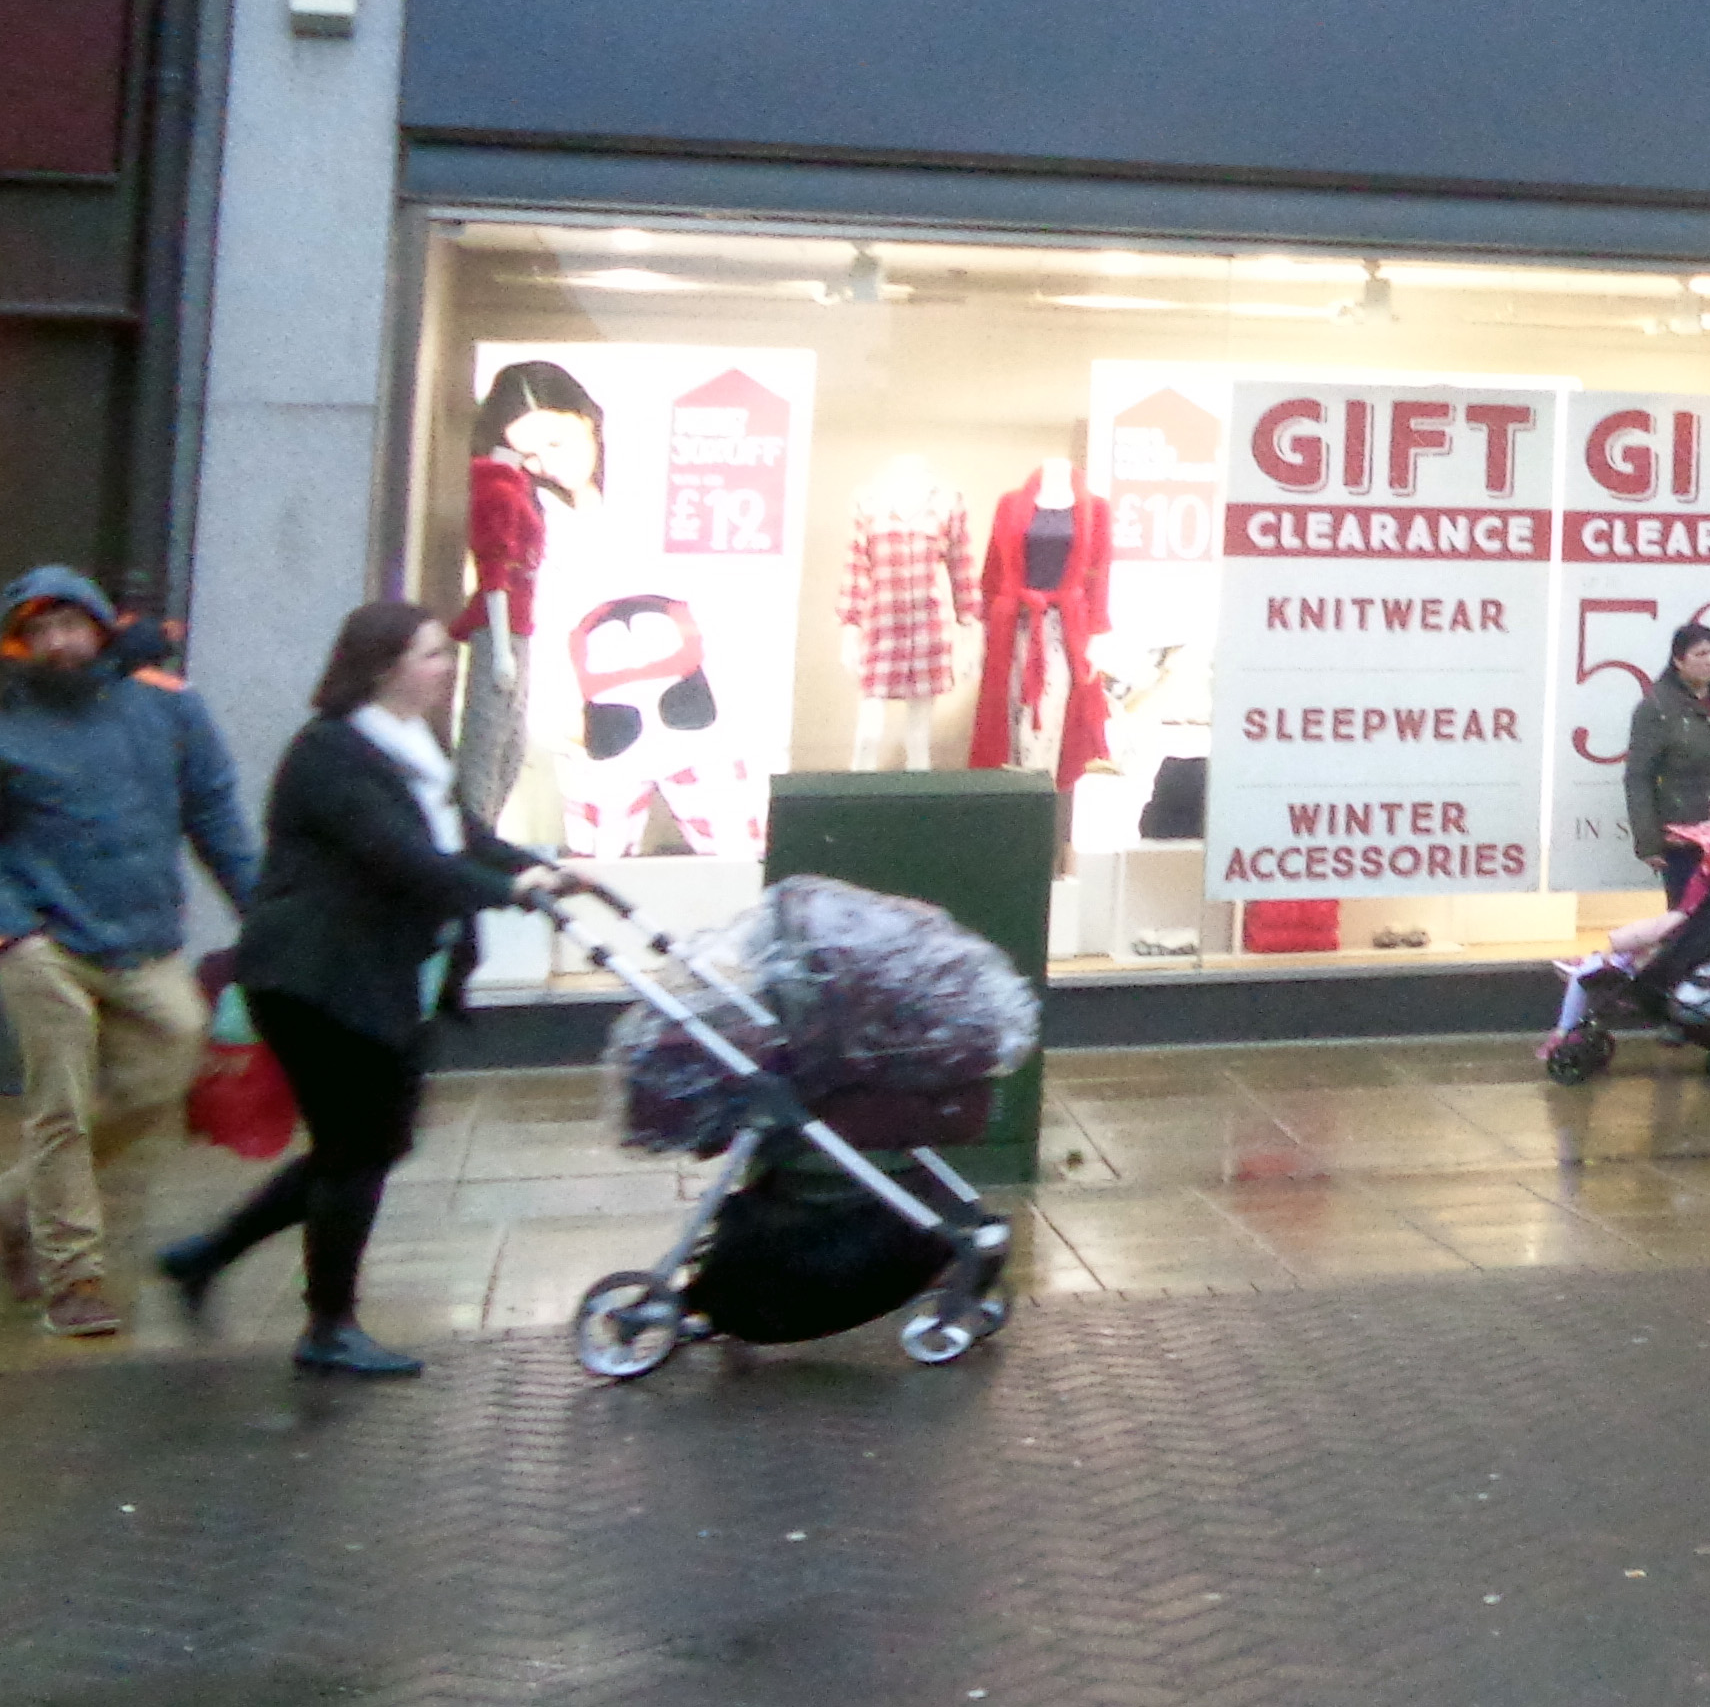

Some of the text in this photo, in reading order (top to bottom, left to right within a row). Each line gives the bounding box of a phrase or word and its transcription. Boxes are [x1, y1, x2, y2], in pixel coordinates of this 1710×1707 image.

[1251, 396, 1537, 499] GIFT
[1114, 493, 1212, 559] £10
[1247, 511, 1535, 554] CLEARANCE
[1267, 596, 1509, 633] KNITWEAR
[1242, 707, 1521, 742] SLEEPWEAR
[1287, 801, 1469, 838] WINTER
[1225, 843, 1528, 883] ACCESSORIES
